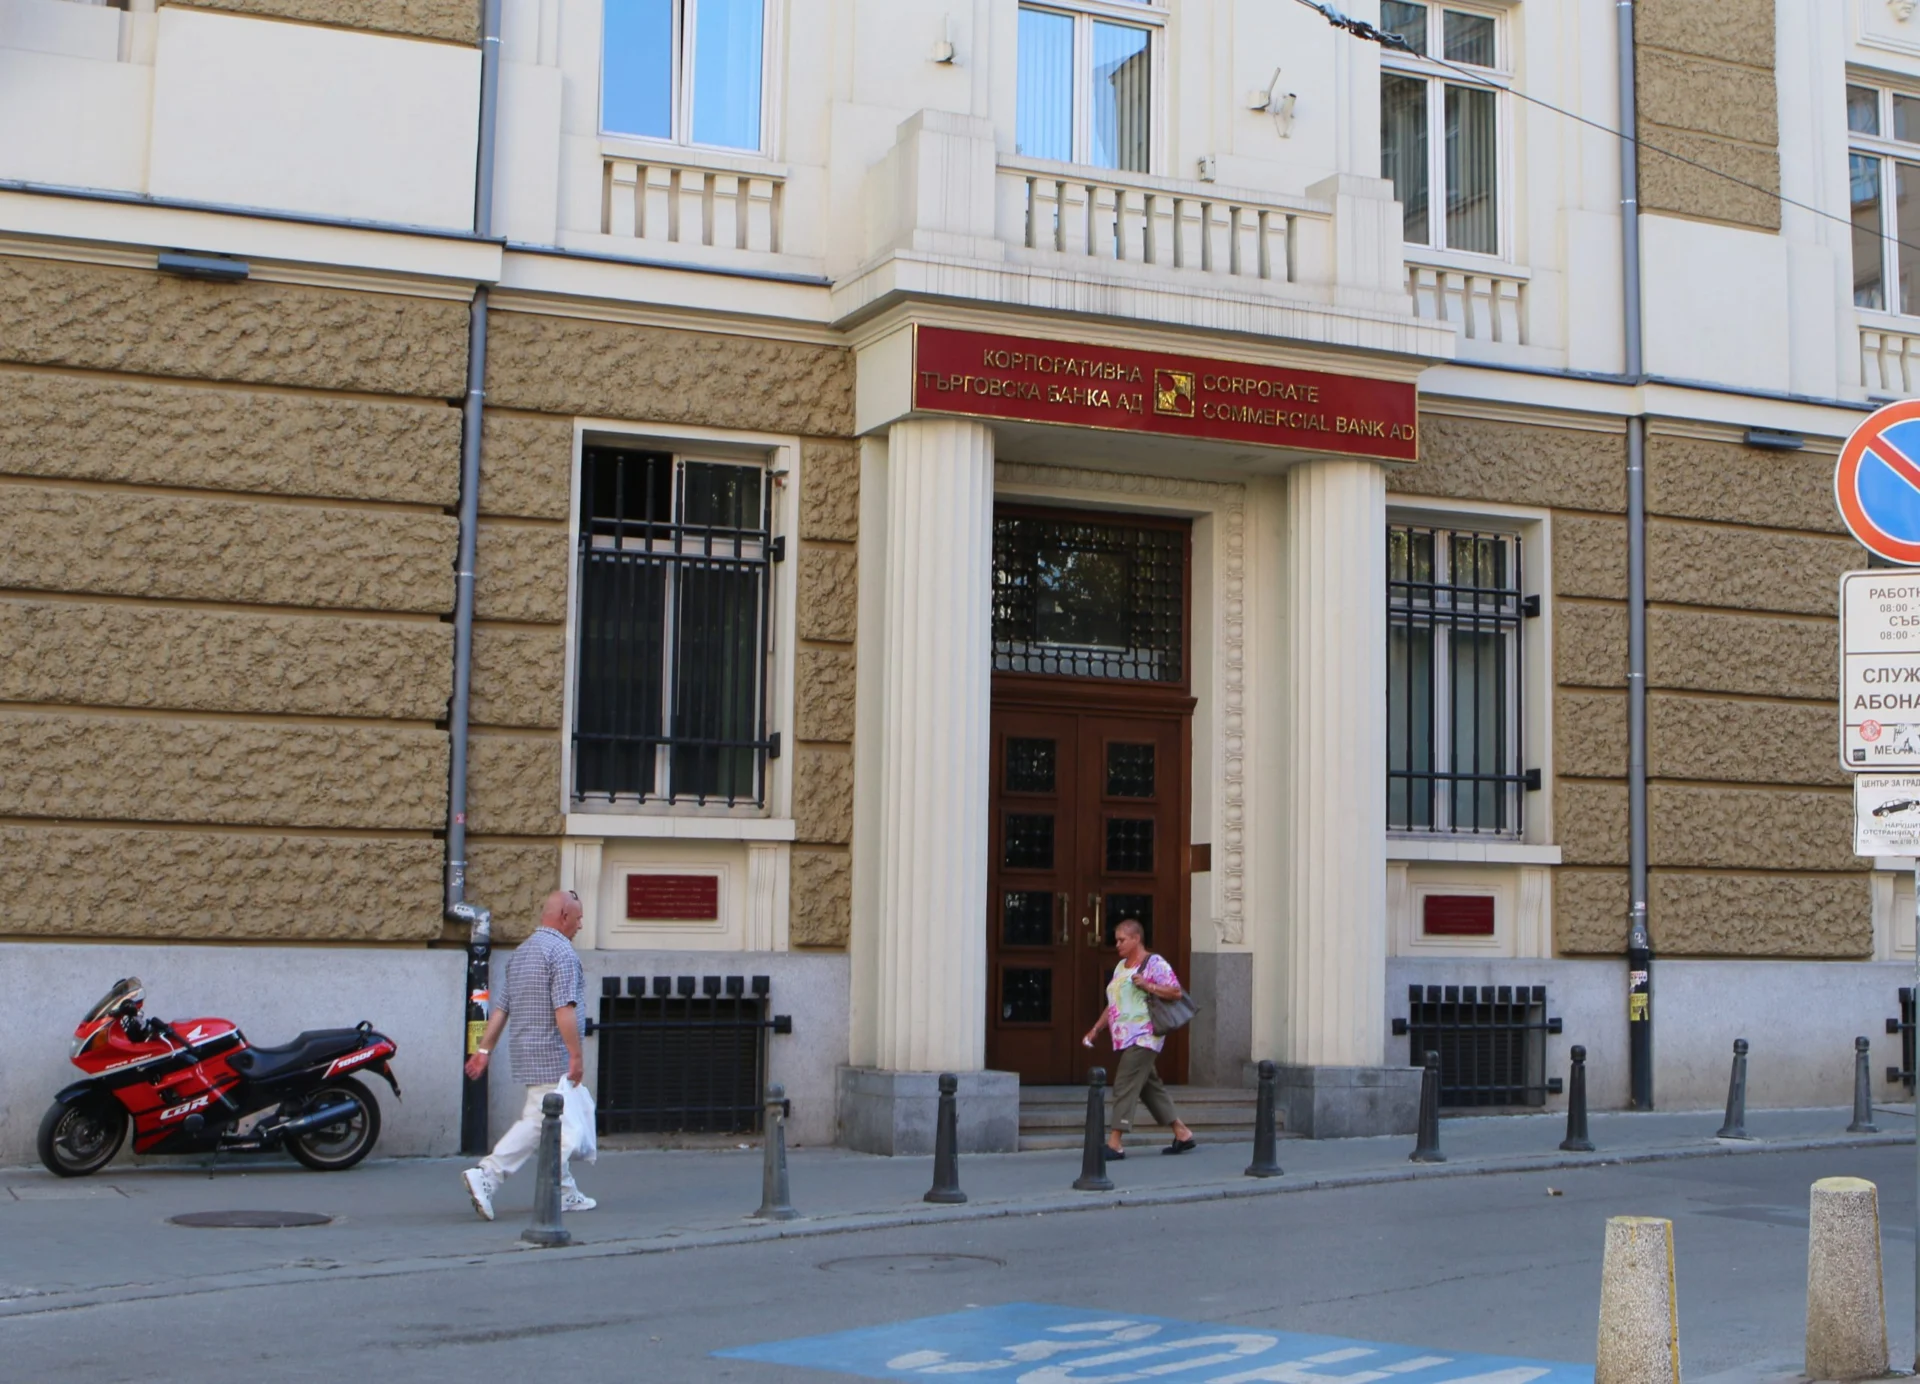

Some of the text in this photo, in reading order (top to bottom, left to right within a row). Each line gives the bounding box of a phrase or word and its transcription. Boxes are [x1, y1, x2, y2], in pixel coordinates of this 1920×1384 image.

[983, 349, 1143, 382] КОРПОРАТИВНА
[921, 371, 1143, 414] ТЪРГОВСКА БАНКА АД
[1203, 374, 1319, 403] CORPORATE
[1203, 401, 1415, 441] COMMERCIAL BANK AD
[1880, 603, 1908, 613] 08:00
[1880, 630, 1908, 641] 08:00
[1861, 779, 1889, 788] ЦЕНТЪР
[1891, 779, 1901, 787] ЗА
[160, 1094, 208, 1120] CBR
